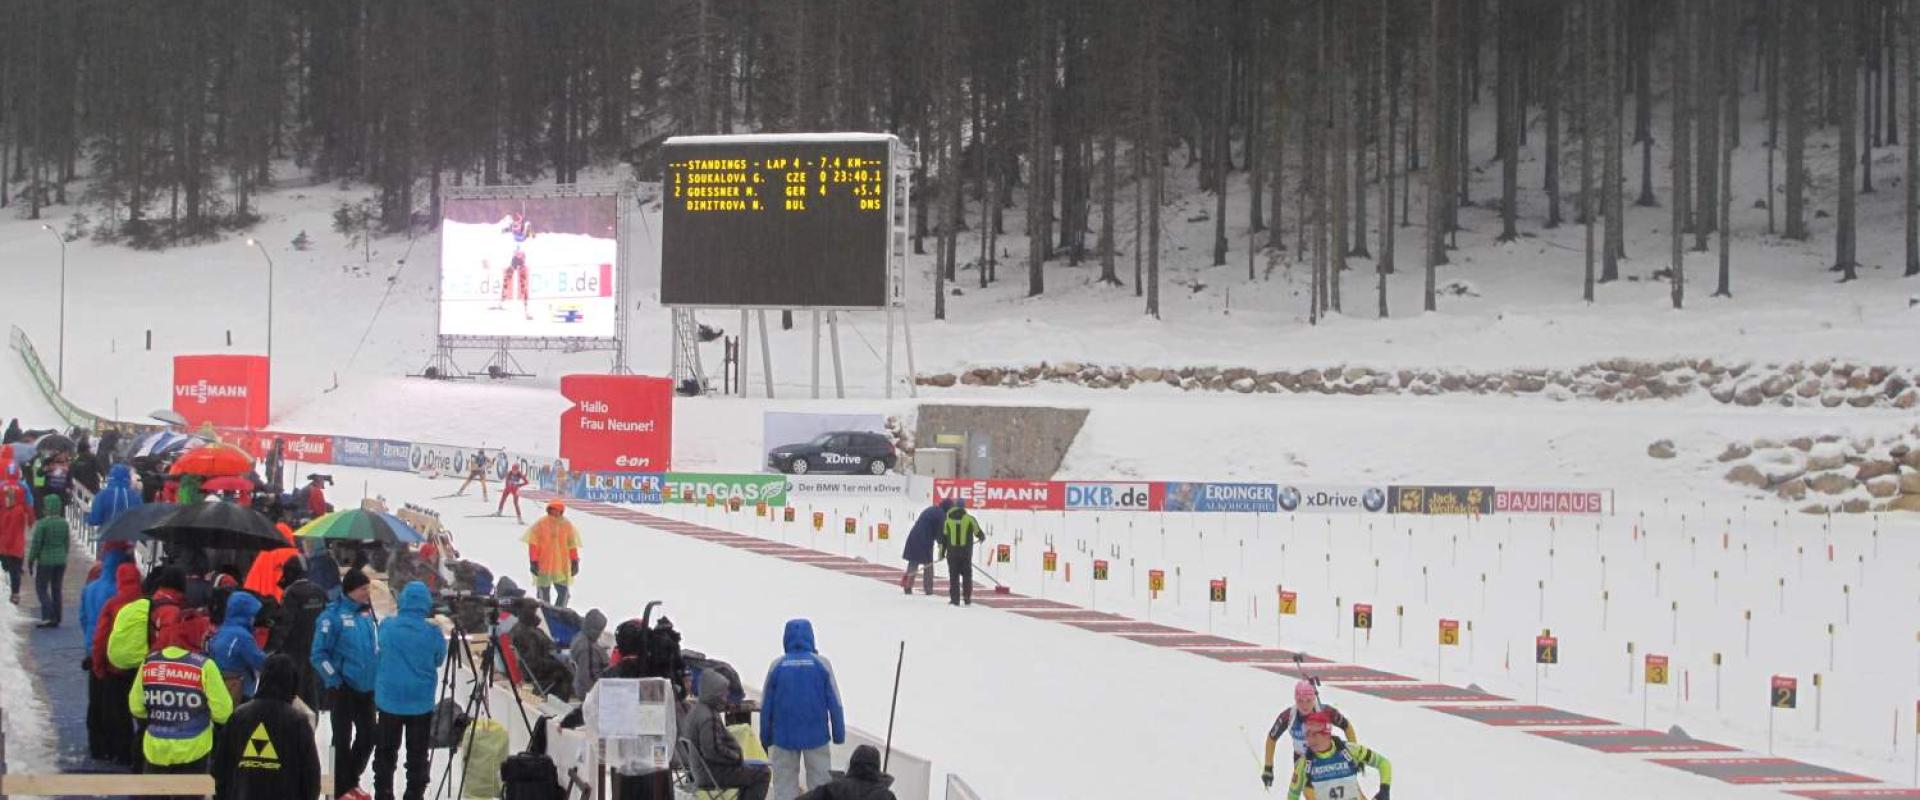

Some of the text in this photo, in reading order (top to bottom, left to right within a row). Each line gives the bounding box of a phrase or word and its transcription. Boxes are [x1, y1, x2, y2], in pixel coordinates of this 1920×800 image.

[767, 158, 787, 169] LAP
[793, 157, 800, 168] 4
[821, 156, 841, 169] 7.4
[675, 170, 881, 183] 1 SOUKALOVA G. CZE 0 23:40.1
[675, 186, 681, 197] 2
[687, 186, 740, 196] GOESSNER
[786, 186, 806, 196] GER
[820, 184, 826, 196] 4
[854, 184, 880, 196] +5.4
[687, 200, 746, 210] DIMITROVA
[785, 200, 805, 210] BUL
[860, 199, 881, 210] DNS
[175, 379, 247, 404] VIESSMANN
[580, 400, 609, 413] Hallo
[580, 416, 654, 431] Frau Neuner!
[826, 453, 861, 464] xDrive
[800, 483, 900, 492] Der BMW 1er mit xDrive
[936, 481, 1048, 508] VIESSMANN
[1206, 484, 1274, 501] ERDINGER
[1066, 486, 1148, 506] DKB.de
[1306, 491, 1359, 507] xDrive
[1496, 492, 1601, 511] BAUHAUS
[1358, 612, 1367, 628] 6
[1444, 628, 1454, 645] 5
[1541, 645, 1552, 662] 4
[1651, 666, 1663, 684] 3
[144, 690, 202, 708] PHOTO
[1777, 688, 1790, 708] 2
[1329, 786, 1344, 800] 47
